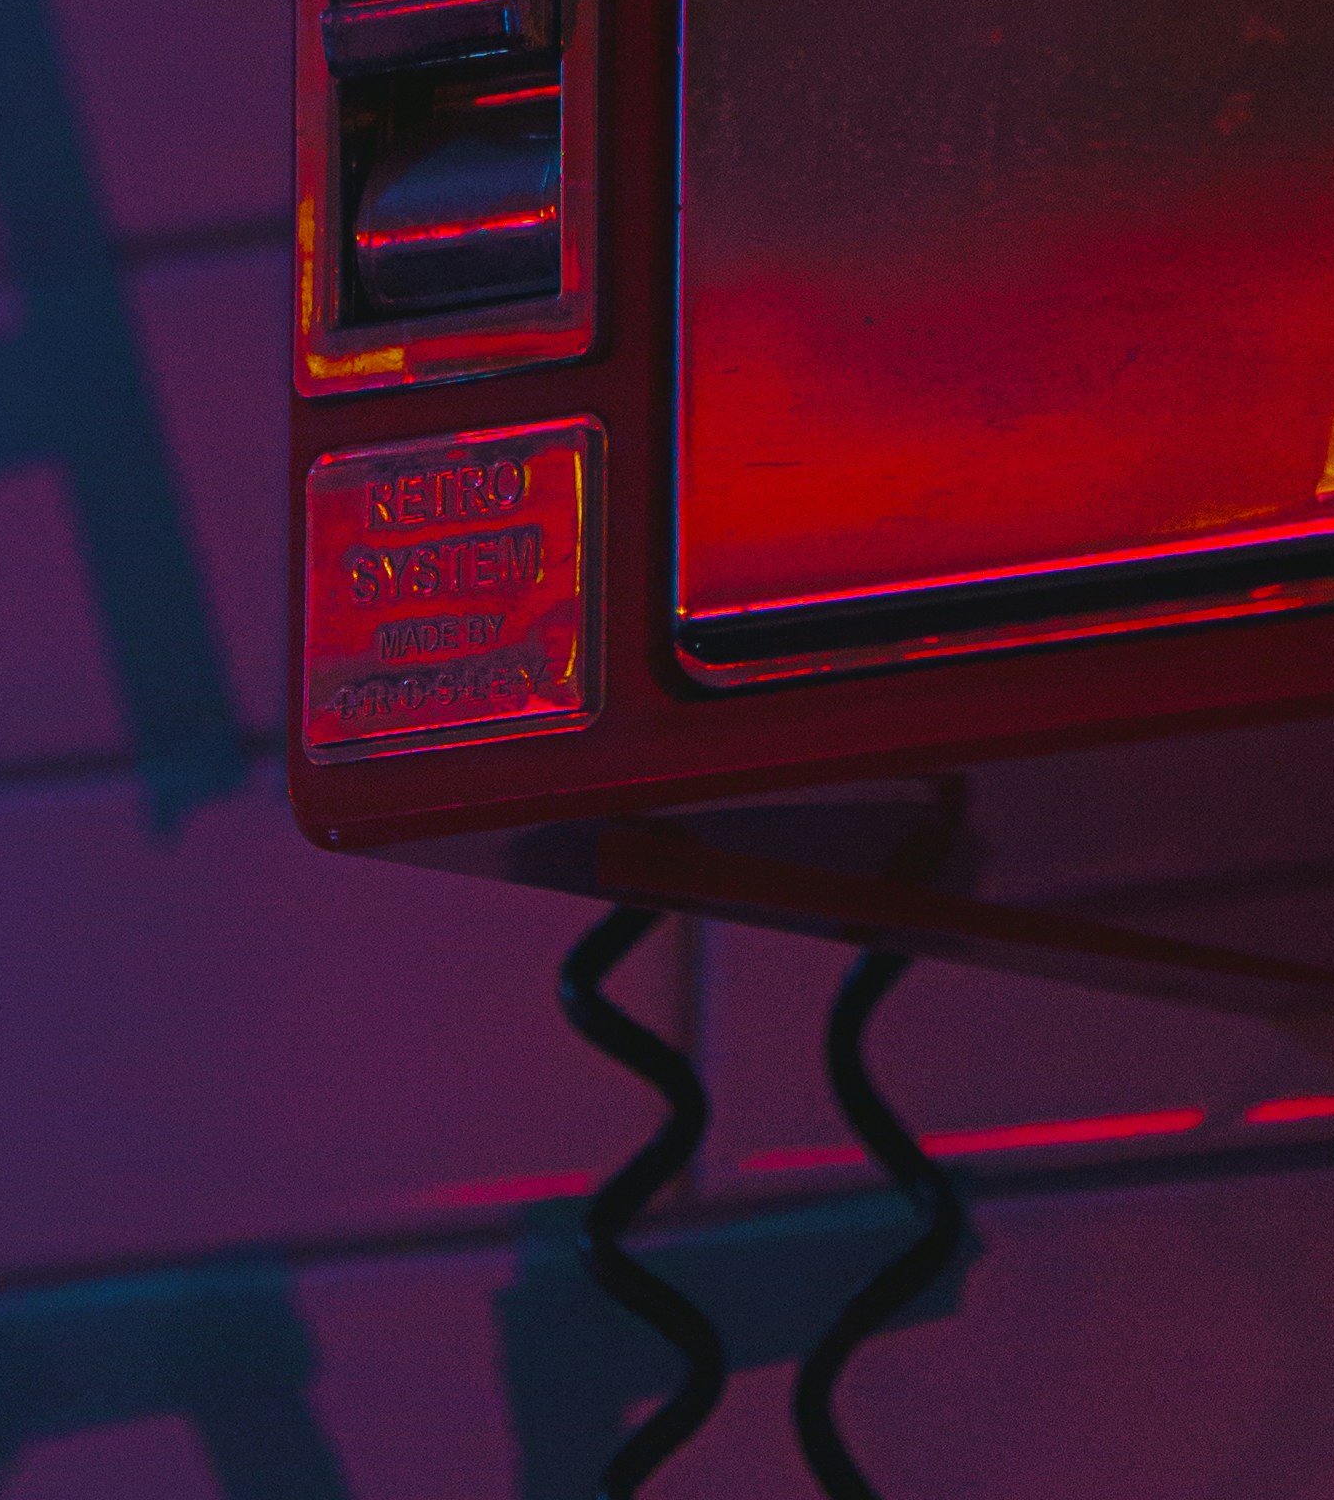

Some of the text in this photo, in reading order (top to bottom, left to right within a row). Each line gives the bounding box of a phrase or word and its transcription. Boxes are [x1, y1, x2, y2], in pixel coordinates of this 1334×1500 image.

[363, 457, 533, 530] RETRO
[350, 525, 547, 605] SYSTEM
[378, 614, 507, 661] MADE BY
[326, 658, 557, 722] CROSLEY
